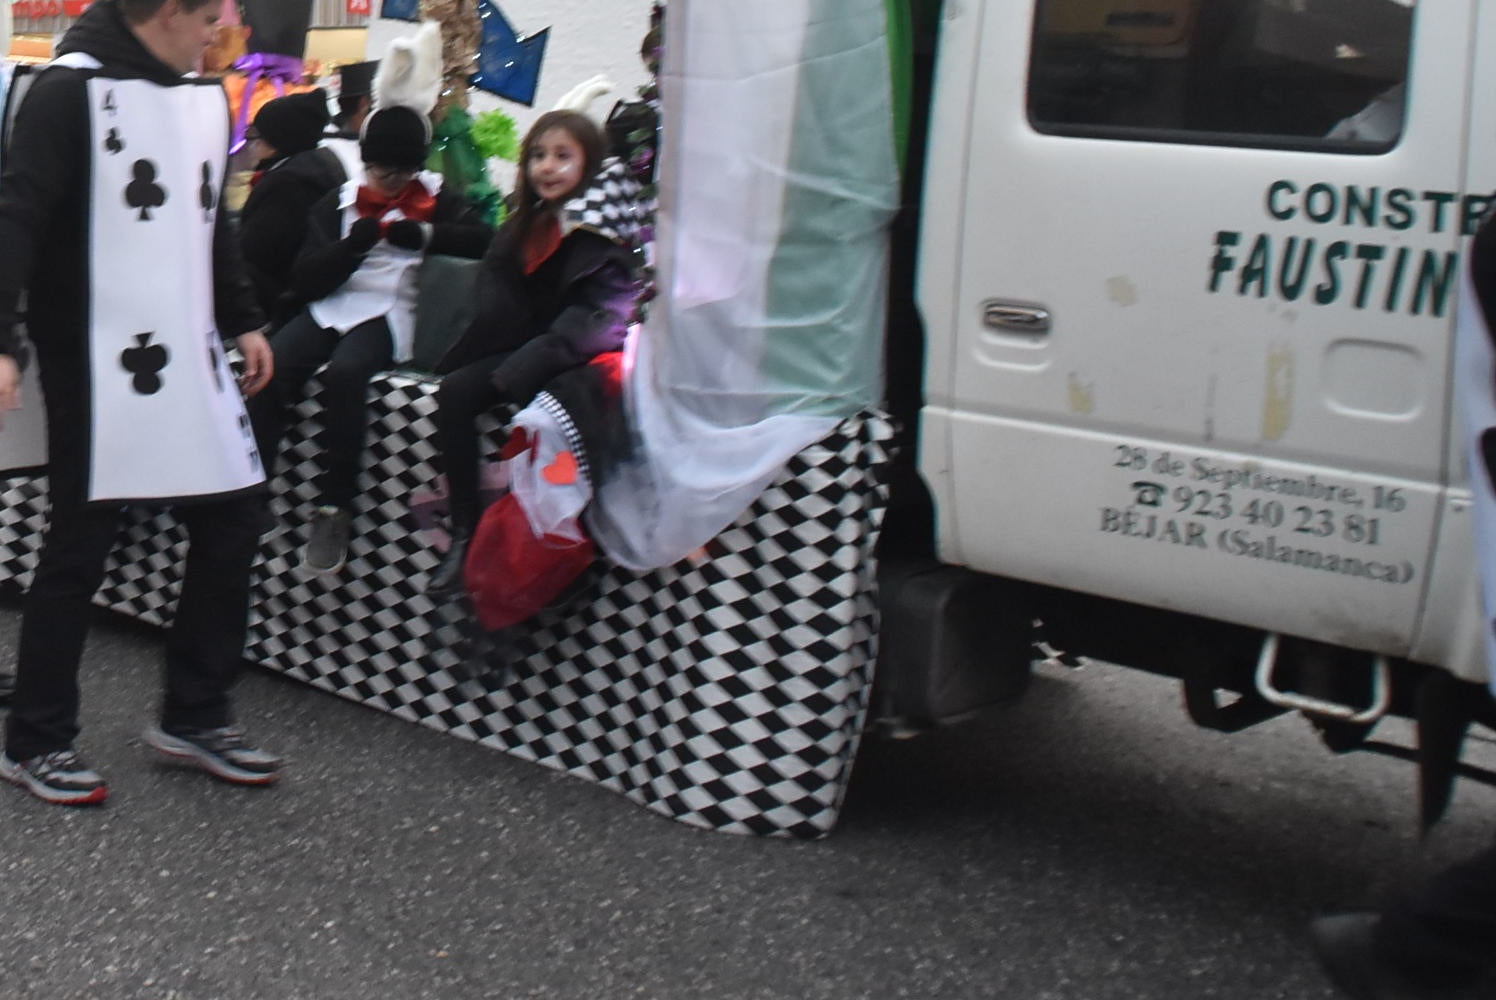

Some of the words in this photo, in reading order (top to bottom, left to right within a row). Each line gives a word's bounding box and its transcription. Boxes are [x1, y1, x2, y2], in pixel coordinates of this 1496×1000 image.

[102, 87, 118, 118] 4
[1114, 444, 1147, 470] 28
[1151, 451, 1185, 477] de
[1191, 456, 1363, 509] Septiembre,
[1372, 485, 1407, 512] 16
[1100, 504, 1208, 550] BÉJAR
[1216, 528, 1416, 585] (Salamanca)
[1172, 485, 1234, 521] 923
[1240, 500, 1284, 528] 40
[1293, 505, 1336, 538] 23
[1342, 513, 1381, 546] 81
